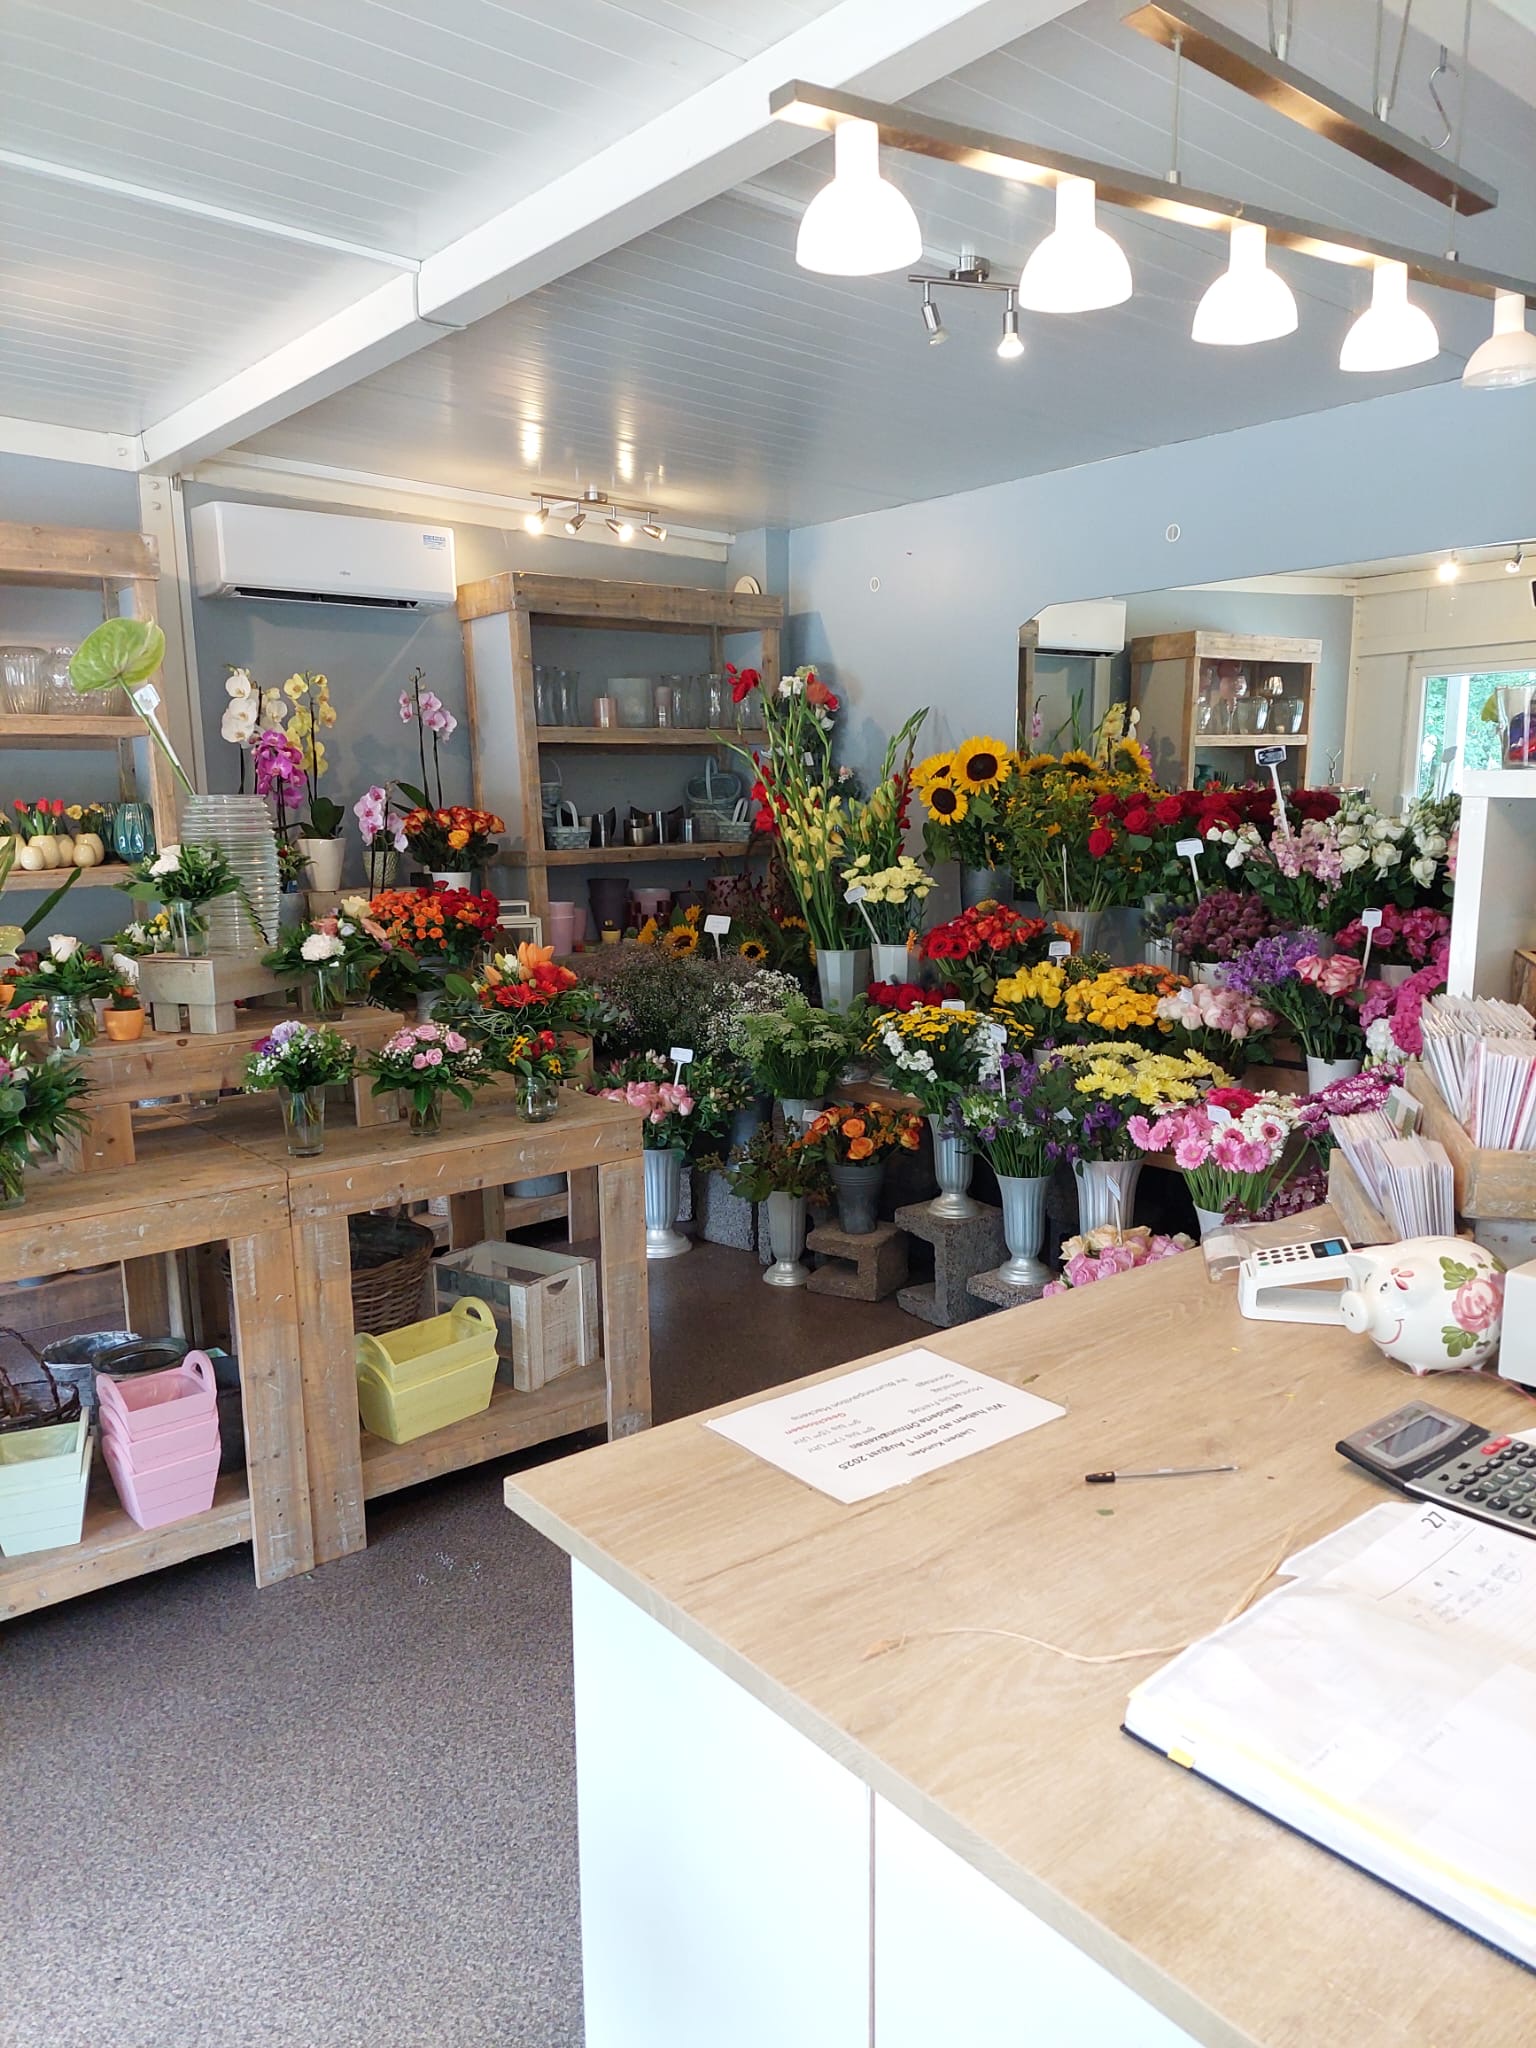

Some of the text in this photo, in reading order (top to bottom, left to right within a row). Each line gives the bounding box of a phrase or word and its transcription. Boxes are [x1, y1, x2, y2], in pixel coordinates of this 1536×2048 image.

[986, 1403, 1007, 1411] Wir
[951, 1409, 988, 1424] haben
[849, 1403, 963, 1449] geänderte Öffnungszeiten
[938, 1422, 953, 1430] ab
[913, 1428, 939, 1440] dem
[865, 1441, 906, 1458] August
[907, 1428, 976, 1457] Lieben Kunden
[838, 1455, 868, 1470] 2025
[1421, 1511, 1447, 1528] 27
